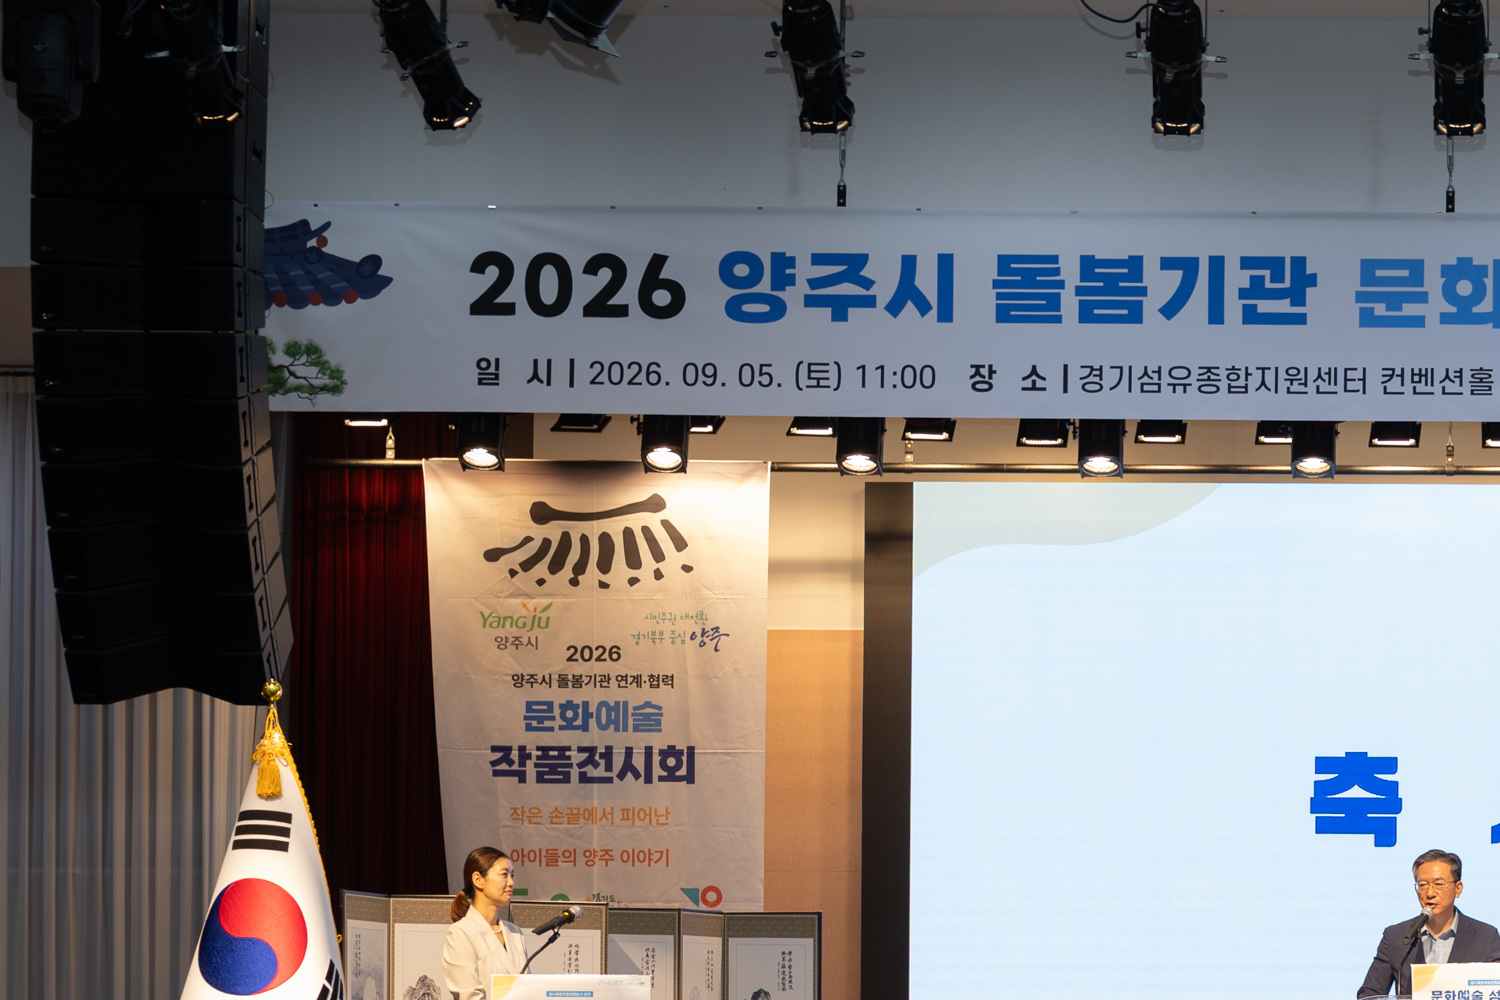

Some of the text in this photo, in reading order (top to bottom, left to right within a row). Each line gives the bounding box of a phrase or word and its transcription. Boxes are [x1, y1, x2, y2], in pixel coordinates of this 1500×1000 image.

[470, 251, 686, 319] 2026
[718, 251, 954, 323] 양주시
[992, 254, 1317, 325] 돌봄기관
[476, 358, 499, 386] 일
[527, 359, 551, 386] 시
[590, 361, 669, 386] 2026.
[683, 363, 725, 386] 09.
[739, 363, 781, 387] 05.
[796, 361, 841, 391] (토)
[857, 365, 935, 389] 11:00
[970, 364, 996, 392] 장
[1021, 365, 1046, 391] 소
[1080, 365, 1366, 394] 경기섬유종합지원센터
[1381, 367, 1494, 395] 컨벤션홀
[644, 612, 677, 626] 시민주권
[494, 635, 539, 651] 양주시
[630, 626, 729, 652] 경기북부 중심 양주
[565, 644, 622, 663] 2026
[511, 672, 675, 689] 양주시 돌봄기관 연계·협력
[523, 700, 663, 732] 문화예술
[489, 745, 695, 784] 작품전시회
[509, 805, 671, 826] 작은 손끝에서 피어난
[509, 847, 670, 868] 아이들의 양주 이야기
